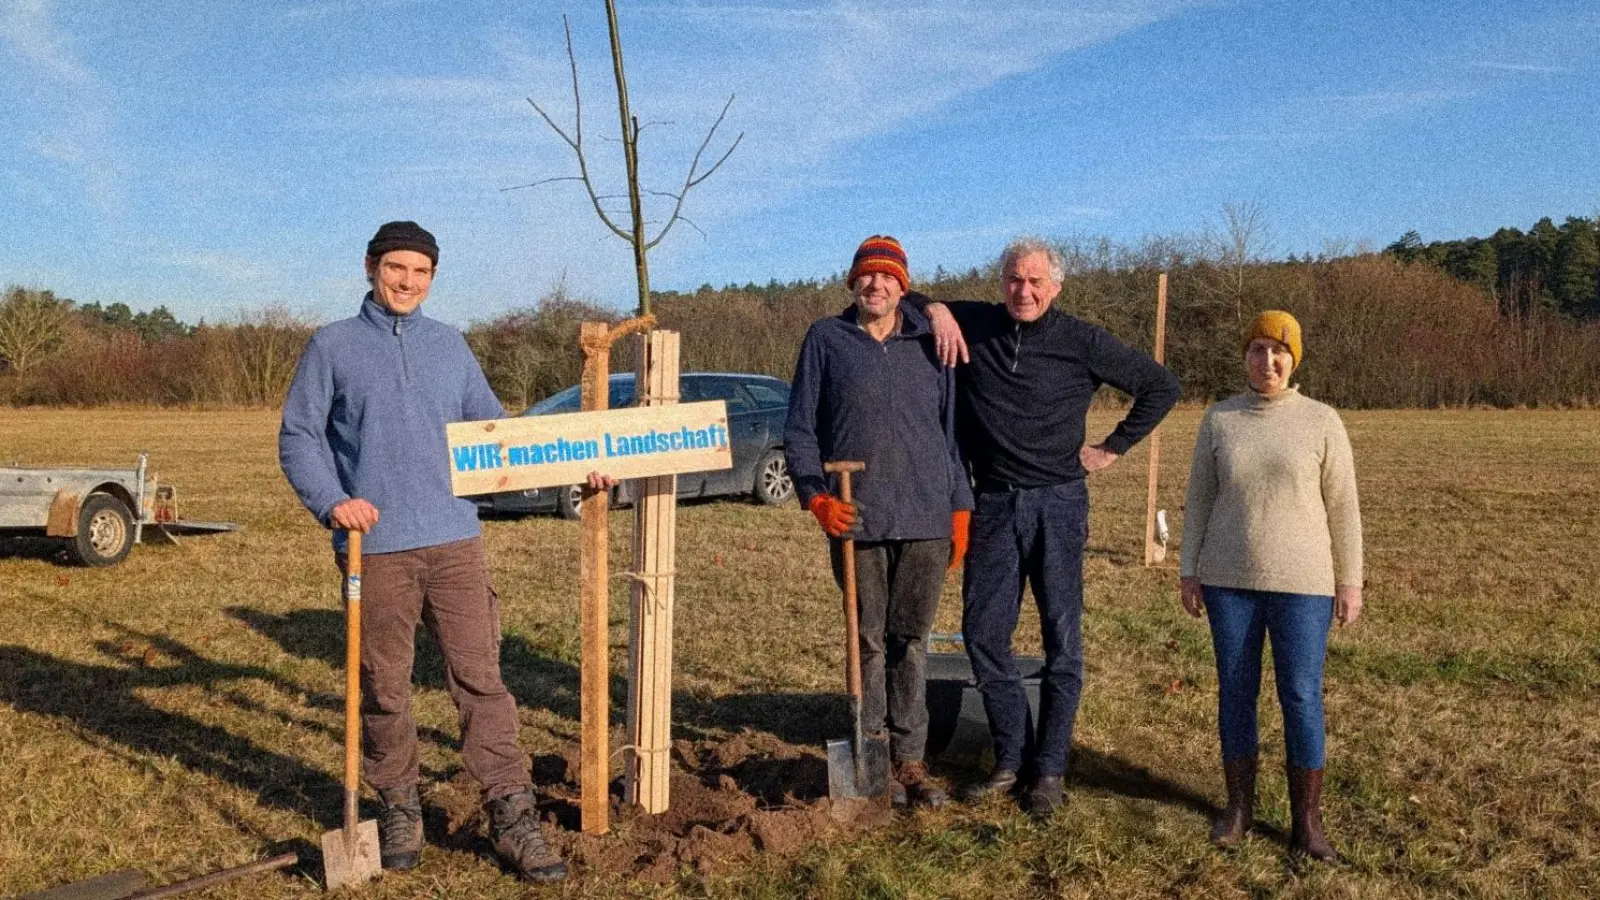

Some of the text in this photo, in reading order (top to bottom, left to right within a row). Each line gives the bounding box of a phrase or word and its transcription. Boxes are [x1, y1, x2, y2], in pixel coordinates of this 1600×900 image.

[452, 424, 728, 472] WIR machen Landschaft
